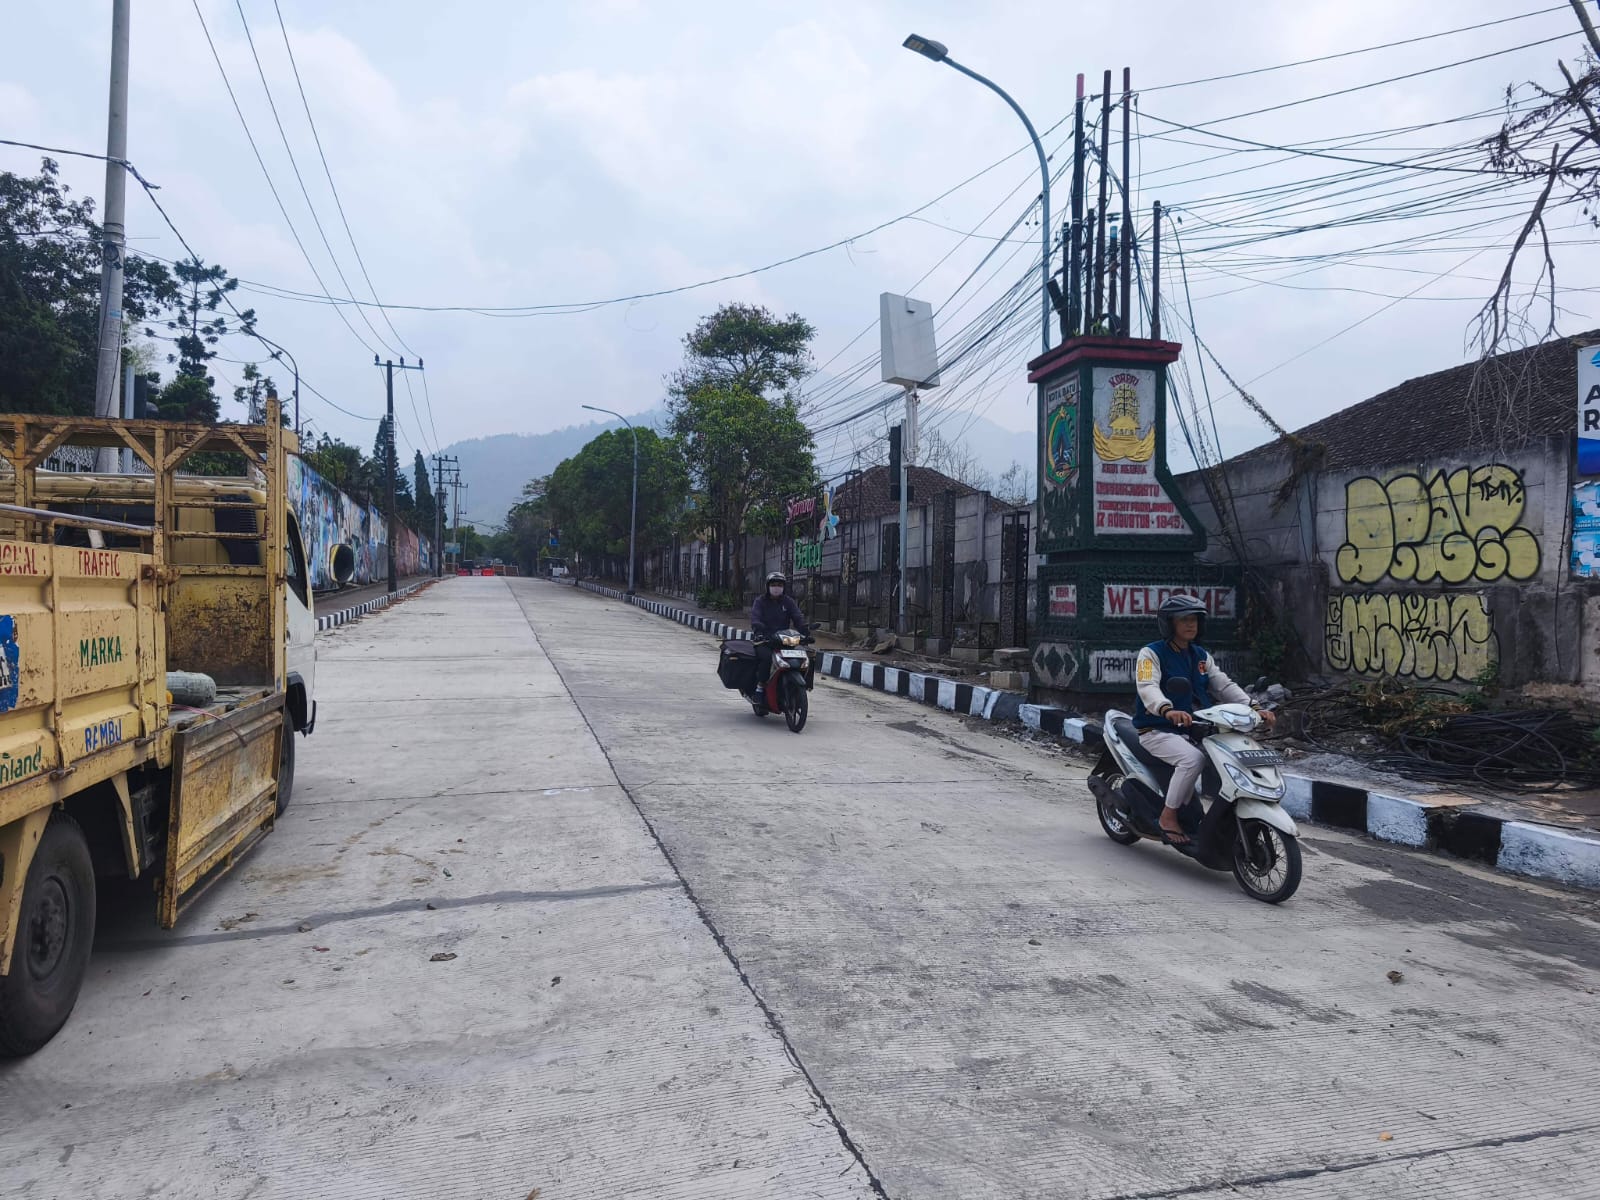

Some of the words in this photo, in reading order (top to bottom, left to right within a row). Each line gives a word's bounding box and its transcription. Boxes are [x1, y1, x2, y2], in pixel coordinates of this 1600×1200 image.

[1108, 372, 1140, 388] KORPRI
[1048, 389, 1061, 402] KOTA
[1062, 383, 1076, 396] BATU
[78, 550, 121, 577] TRAFFIC
[79, 635, 123, 668] MARKA
